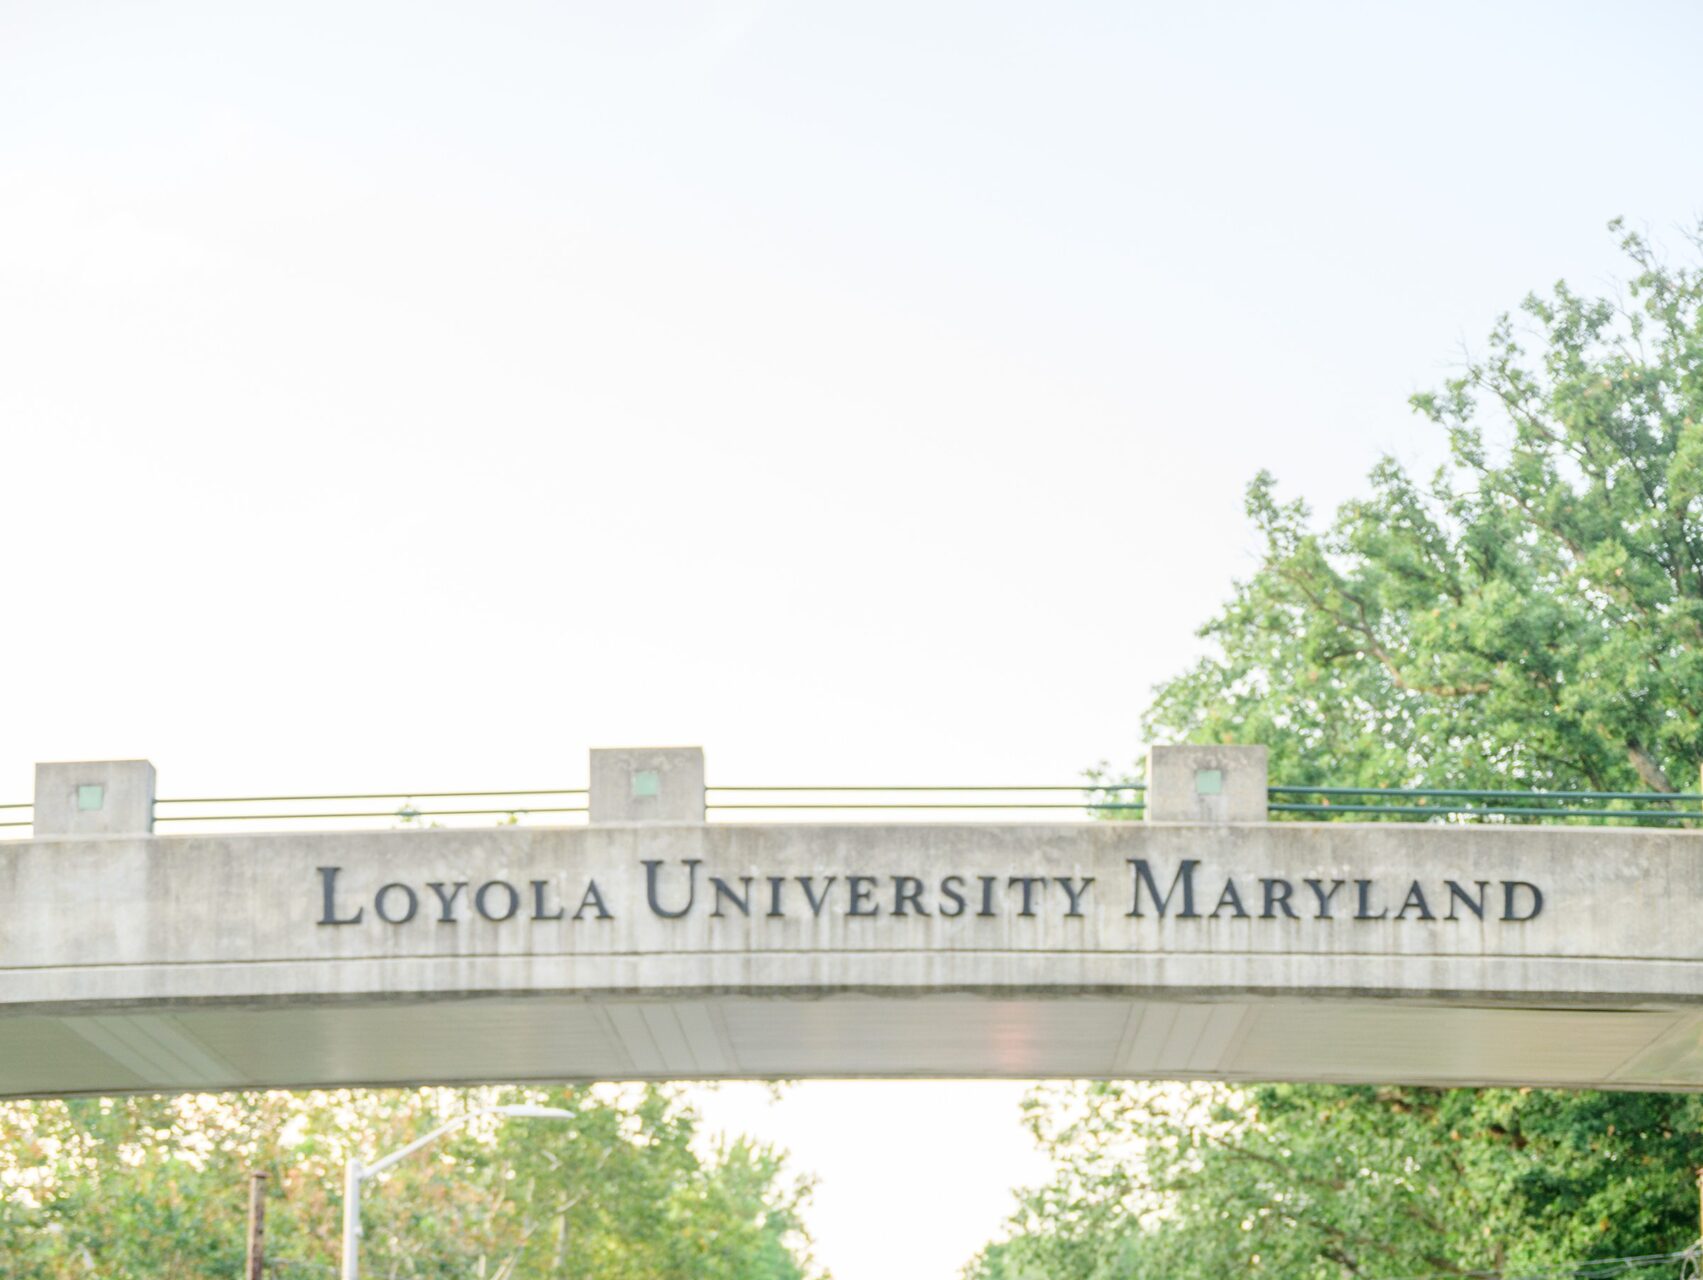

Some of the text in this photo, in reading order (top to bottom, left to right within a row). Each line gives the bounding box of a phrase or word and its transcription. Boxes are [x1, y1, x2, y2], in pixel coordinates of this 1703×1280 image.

[316, 858, 1545, 927] LOYOLA UNIVERSITY MARYLAND
